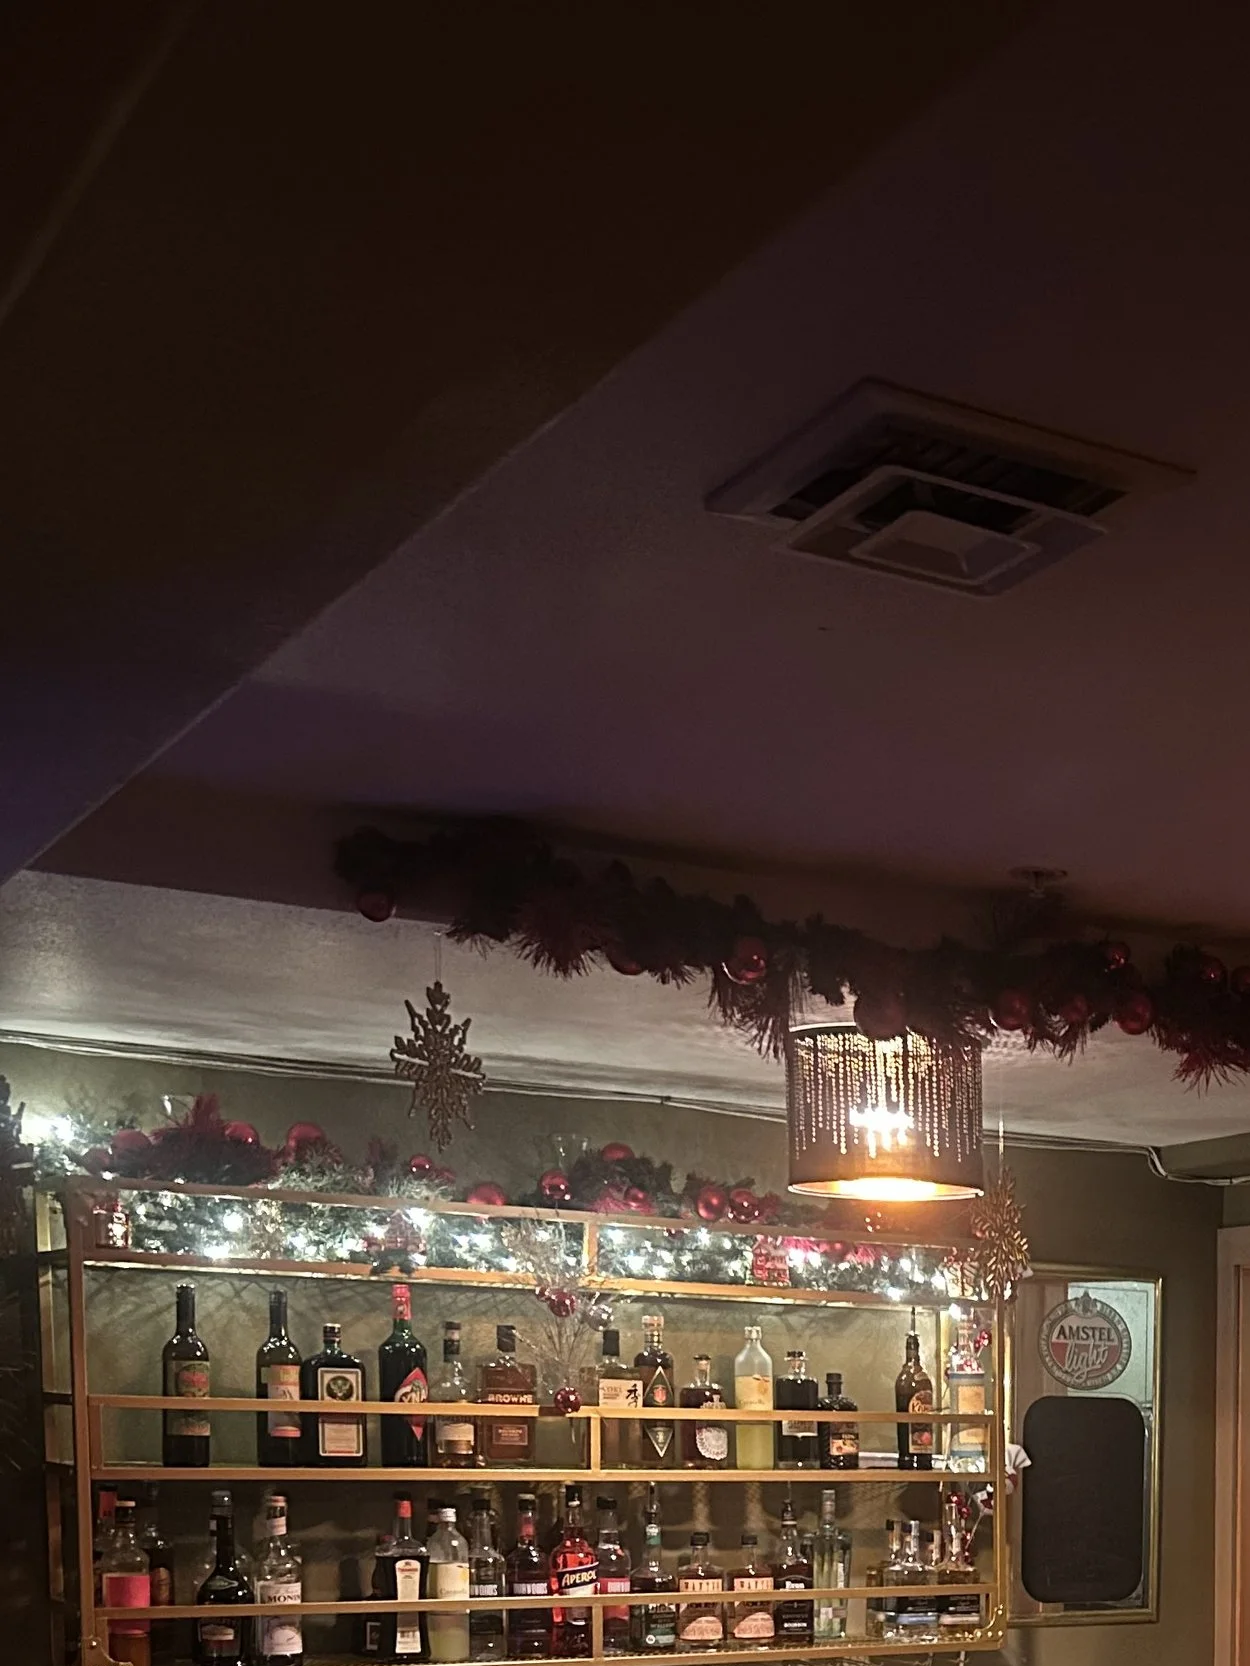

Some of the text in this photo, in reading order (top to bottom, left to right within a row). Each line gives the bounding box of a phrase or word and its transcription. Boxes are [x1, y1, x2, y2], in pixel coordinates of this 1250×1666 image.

[1056, 1325, 1114, 1342] AMSTEL
[1065, 1340, 1109, 1382] light
[561, 1569, 597, 1587] APEROL
